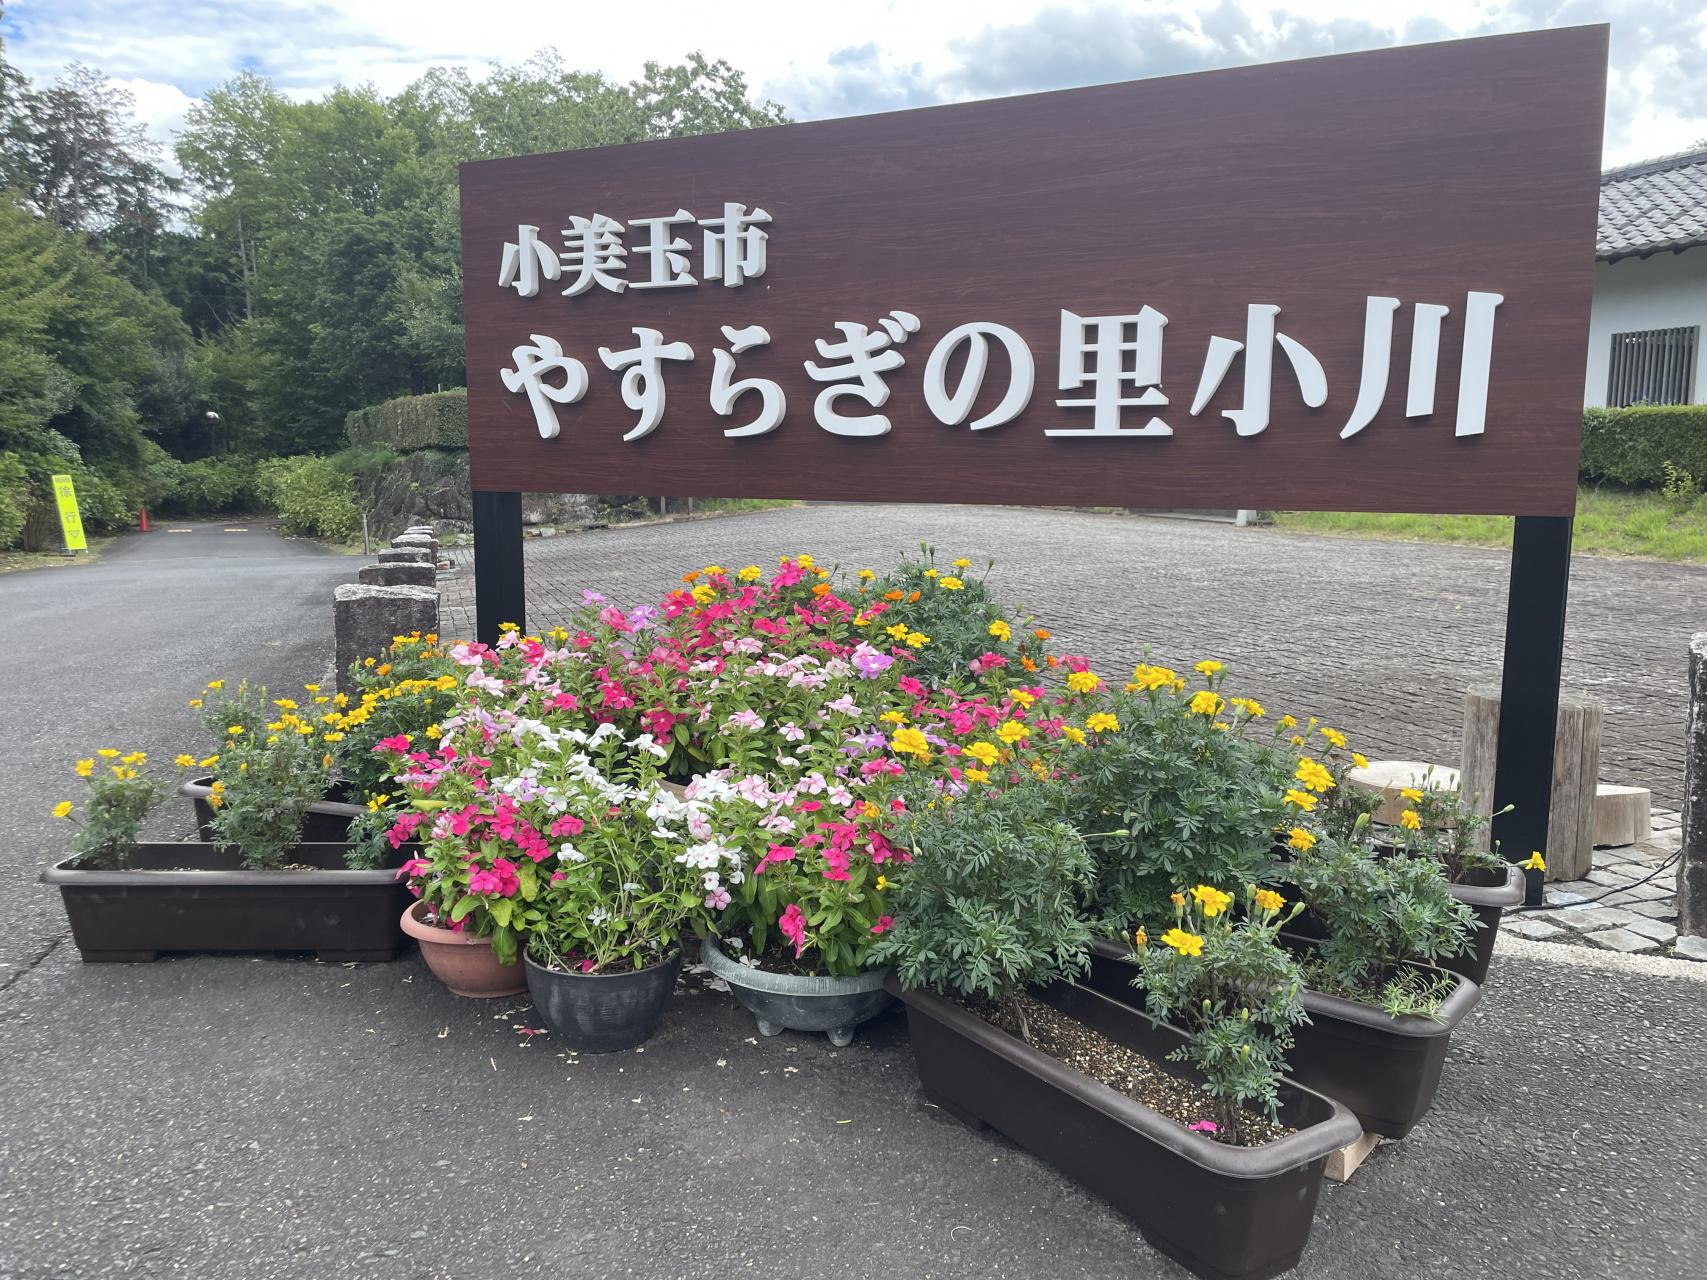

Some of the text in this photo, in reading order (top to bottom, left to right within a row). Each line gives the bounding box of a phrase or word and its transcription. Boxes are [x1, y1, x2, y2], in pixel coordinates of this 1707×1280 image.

[498, 202, 773, 298] 小美玉市
[499, 290, 1505, 443] やすらぎの里小川
